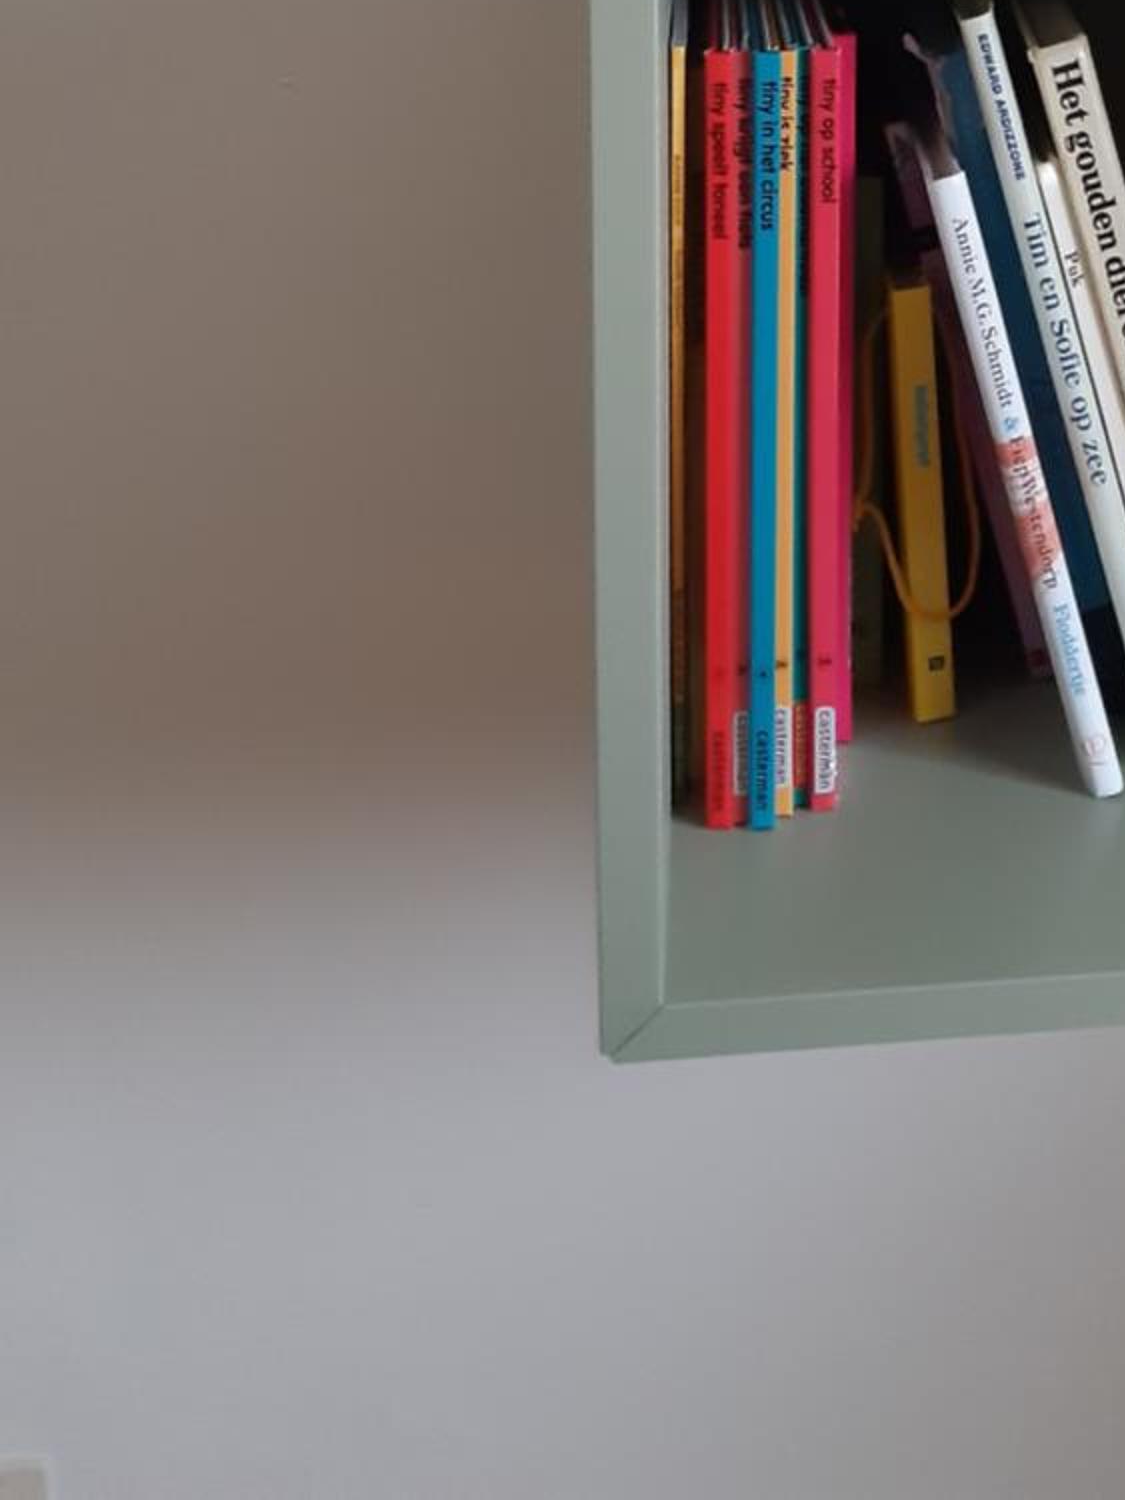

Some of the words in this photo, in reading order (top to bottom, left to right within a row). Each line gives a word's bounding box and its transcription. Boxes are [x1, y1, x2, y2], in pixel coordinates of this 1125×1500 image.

[710, 83, 728, 114] tiny
[758, 81, 778, 114] tiny
[819, 78, 836, 111] tiny
[1052, 60, 1089, 127] Het
[710, 122, 729, 176] speelt
[762, 121, 777, 137] in
[818, 117, 835, 140] op
[762, 145, 777, 174] het
[822, 147, 837, 204] school
[713, 183, 729, 239] toneel
[760, 180, 777, 231] circus
[1064, 131, 1118, 251] gouden
[978, 33, 1003, 96] EDWARD
[995, 100, 1026, 181] ARDIZZONE
[1023, 212, 1050, 268] Tim
[1039, 276, 1061, 311] en
[1050, 318, 1082, 388] Sofie
[1070, 397, 1092, 432] op
[1082, 438, 1108, 487] zee
[1064, 249, 1085, 288] Puk
[952, 217, 977, 274] Annie
[981, 326, 1015, 408] Schmidt
[756, 730, 769, 811] casterman
[818, 710, 832, 790] casterman
